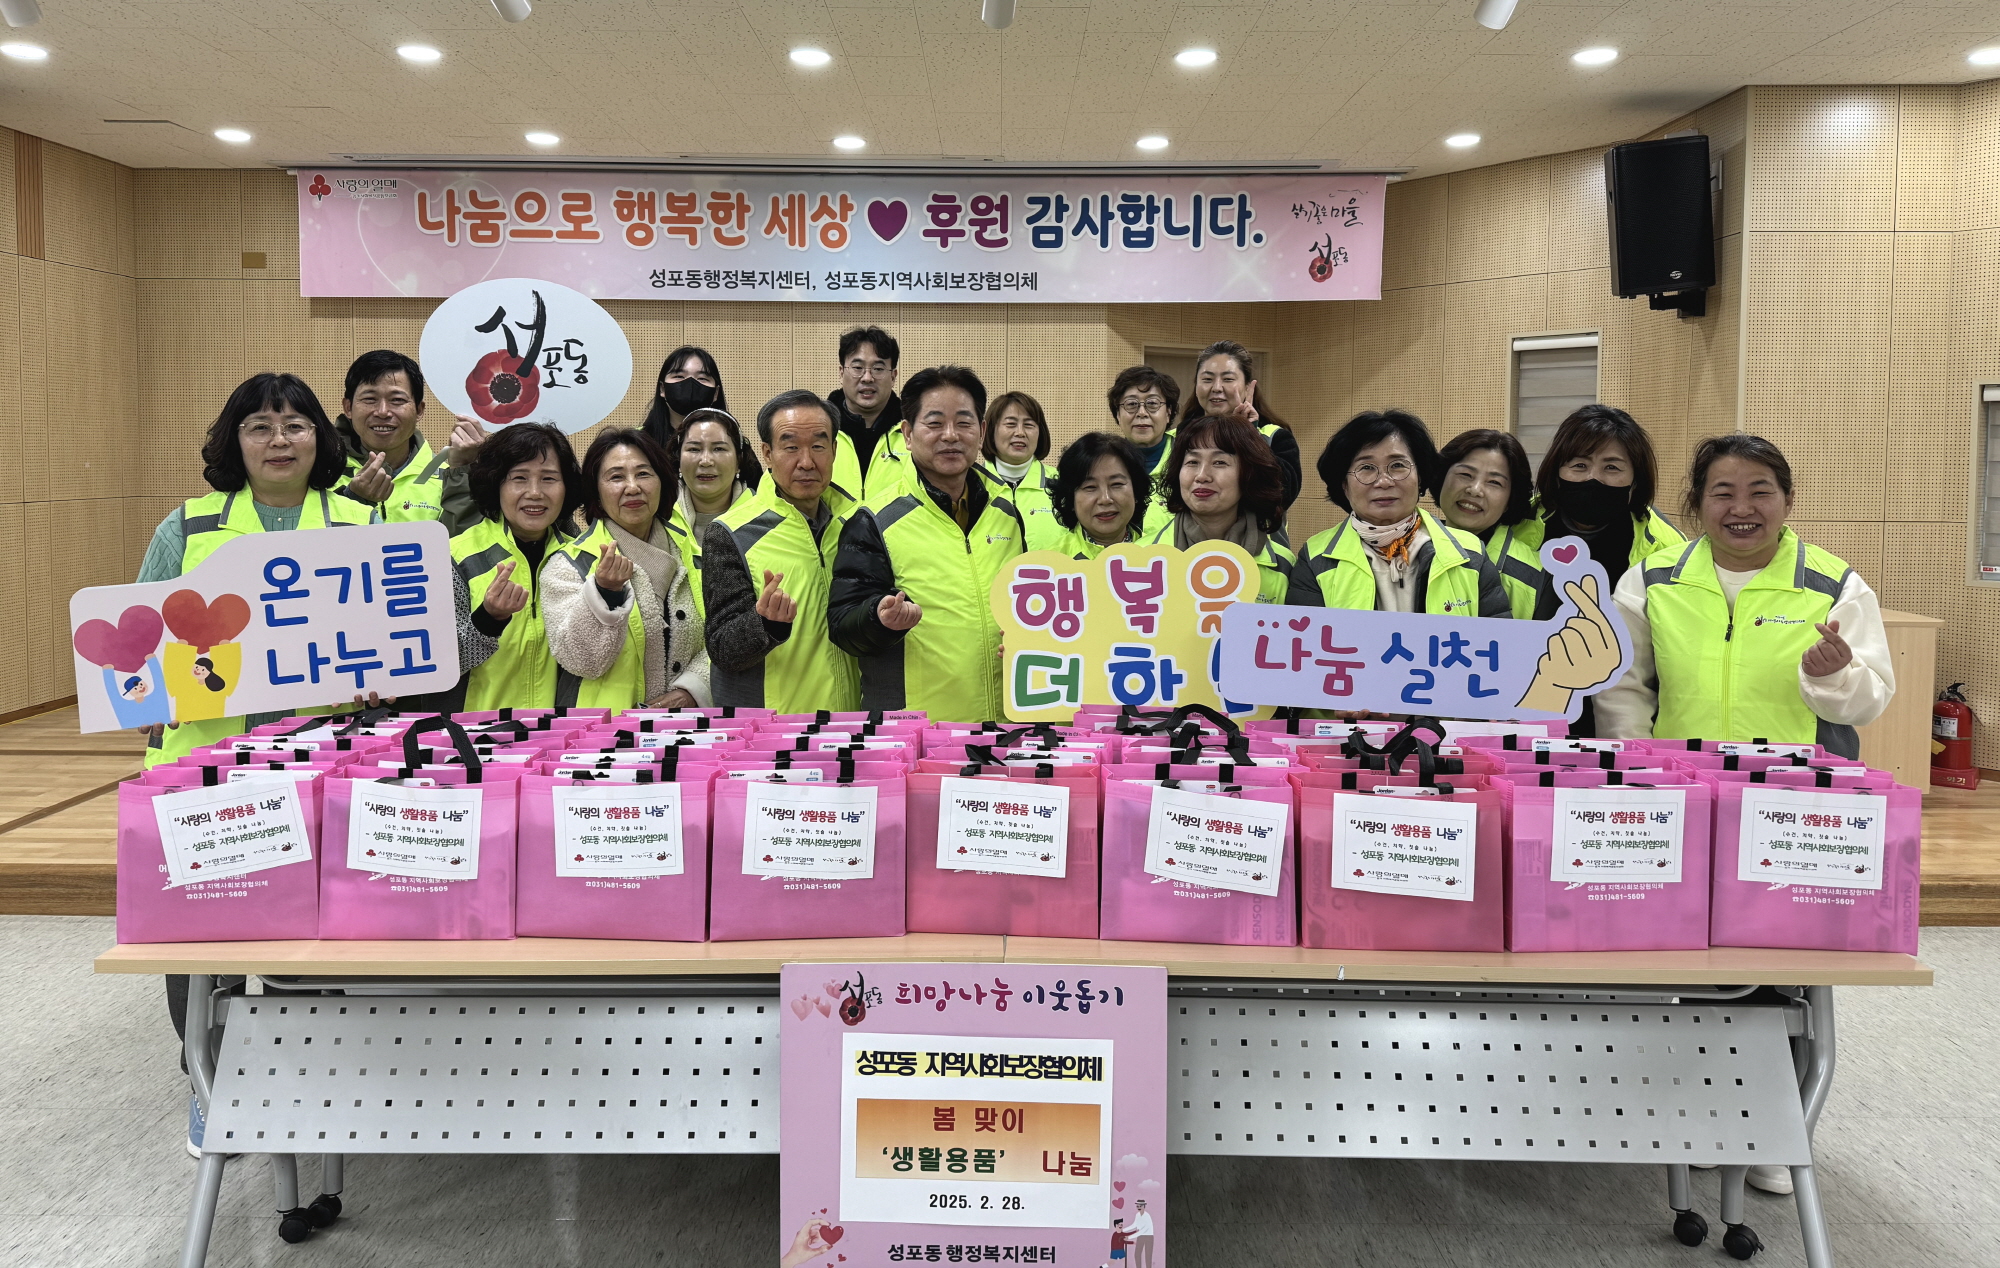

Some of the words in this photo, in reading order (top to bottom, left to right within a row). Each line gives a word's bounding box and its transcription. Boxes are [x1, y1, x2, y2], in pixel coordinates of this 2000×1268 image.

[415, 188, 602, 248] 나눔으로
[613, 189, 752, 249] 행복한
[763, 190, 856, 250] 세상
[922, 192, 1011, 250] 후원
[1025, 193, 1267, 250] 감사합니다.
[649, 269, 816, 291] 성포동행정복지센터,
[824, 270, 1038, 291] 성포동지역사회보장협의체
[465, 289, 589, 425] 성포동
[259, 542, 429, 628] 온기를
[266, 628, 437, 689] 나누고
[1254, 624, 1366, 697] 나눔
[1380, 630, 1500, 705] 실천
[215, 803, 256, 822] 생활용품
[399, 807, 439, 822] 생활용품
[603, 806, 641, 820] 생활용품
[799, 809, 837, 823] 생활용품
[992, 801, 1030, 816] 생활용품
[1608, 811, 1647, 824] 생활용품
[1204, 818, 1244, 836] 생활용품
[1800, 813, 1843, 828] 생활용품
[192, 840, 216, 852] 성포동
[219, 824, 291, 846] 지역사회보장협의체
[373, 831, 395, 843] 성포동
[396, 835, 465, 847] 지역사회보장협의체
[579, 835, 600, 845] 성포동
[602, 833, 669, 845] 지역사회보장협의체
[964, 827, 986, 839] 성포동
[989, 830, 1054, 844] 지역사회보장협의체
[1390, 823, 1432, 839] 생활용품
[770, 836, 792, 846] 성포동
[795, 837, 861, 849] 지역사회보장협의체
[1580, 839, 1603, 850] 성포동
[1605, 839, 1670, 850] 지역사회보장협의체
[1769, 839, 1793, 851] 성포동
[1797, 841, 1869, 855] 지역사회보장협의체
[1174, 840, 1196, 853] 성포동
[1199, 846, 1268, 864] 지역사회보장협의체
[1360, 850, 1385, 861] 성포동
[1387, 852, 1459, 867] 지역사회보장협의체
[895, 977, 1013, 1013] 희망나눔
[1023, 979, 1124, 1015] 이웃돕기
[856, 1050, 918, 1076] 성포동
[924, 1051, 1103, 1082] 지역사회보장협의체
[932, 1106, 956, 1132] 봄
[974, 1107, 1024, 1134] 맞이
[1042, 1150, 1093, 1177] 나눔
[929, 1193, 972, 1209] 2025.
[980, 1195, 994, 1210] 2.
[1002, 1195, 1026, 1211] 28.
[887, 1244, 942, 1262] 성포동
[946, 1244, 1057, 1264] 행정복지센터
